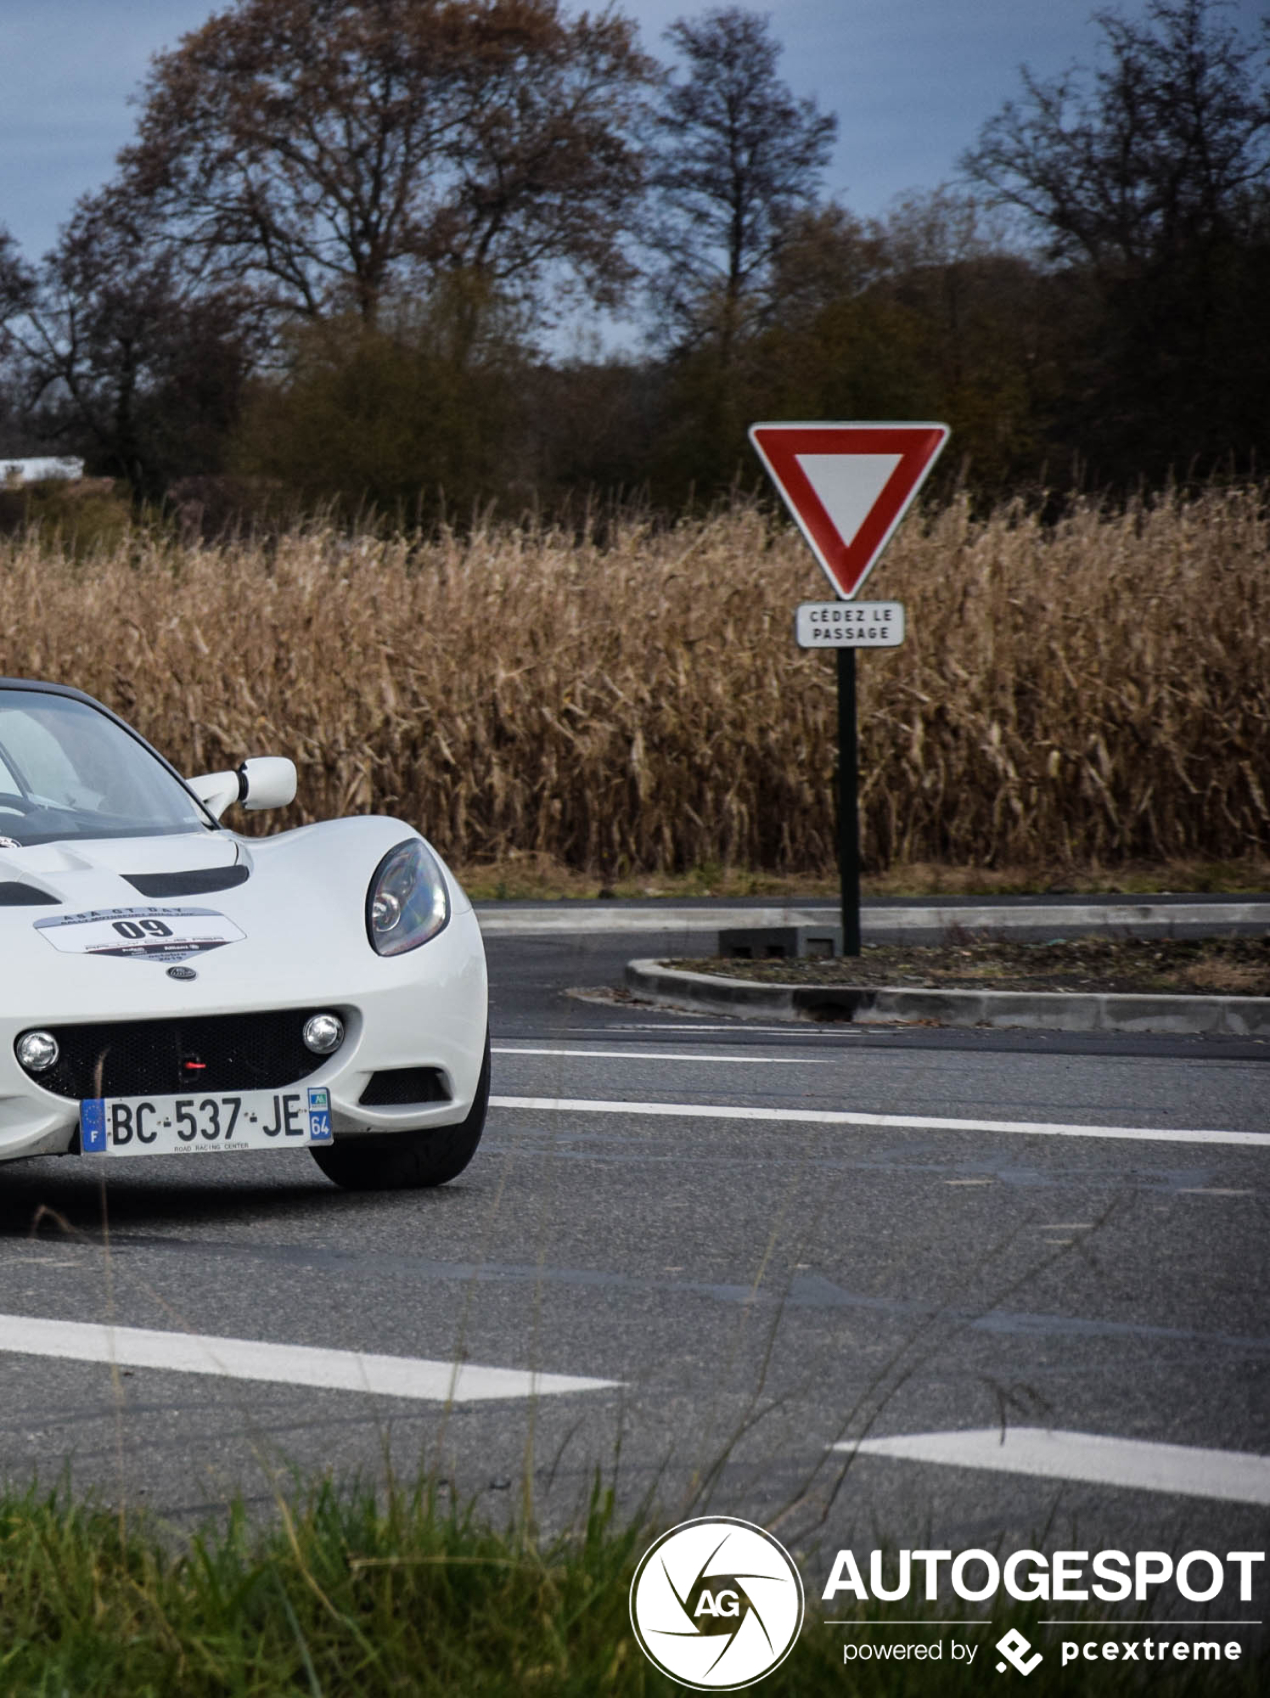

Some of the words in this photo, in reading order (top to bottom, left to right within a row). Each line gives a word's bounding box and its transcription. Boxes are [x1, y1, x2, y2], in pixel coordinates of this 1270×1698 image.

[809, 608, 866, 623] CÉDEZ
[873, 609, 893, 622] LE
[813, 626, 889, 640] PASSAGE
[63, 911, 101, 920] ASA
[111, 919, 174, 940] 09
[311, 1115, 330, 1135] 64
[90, 1130, 98, 1143] F
[224, 1142, 249, 1150] CENTER
